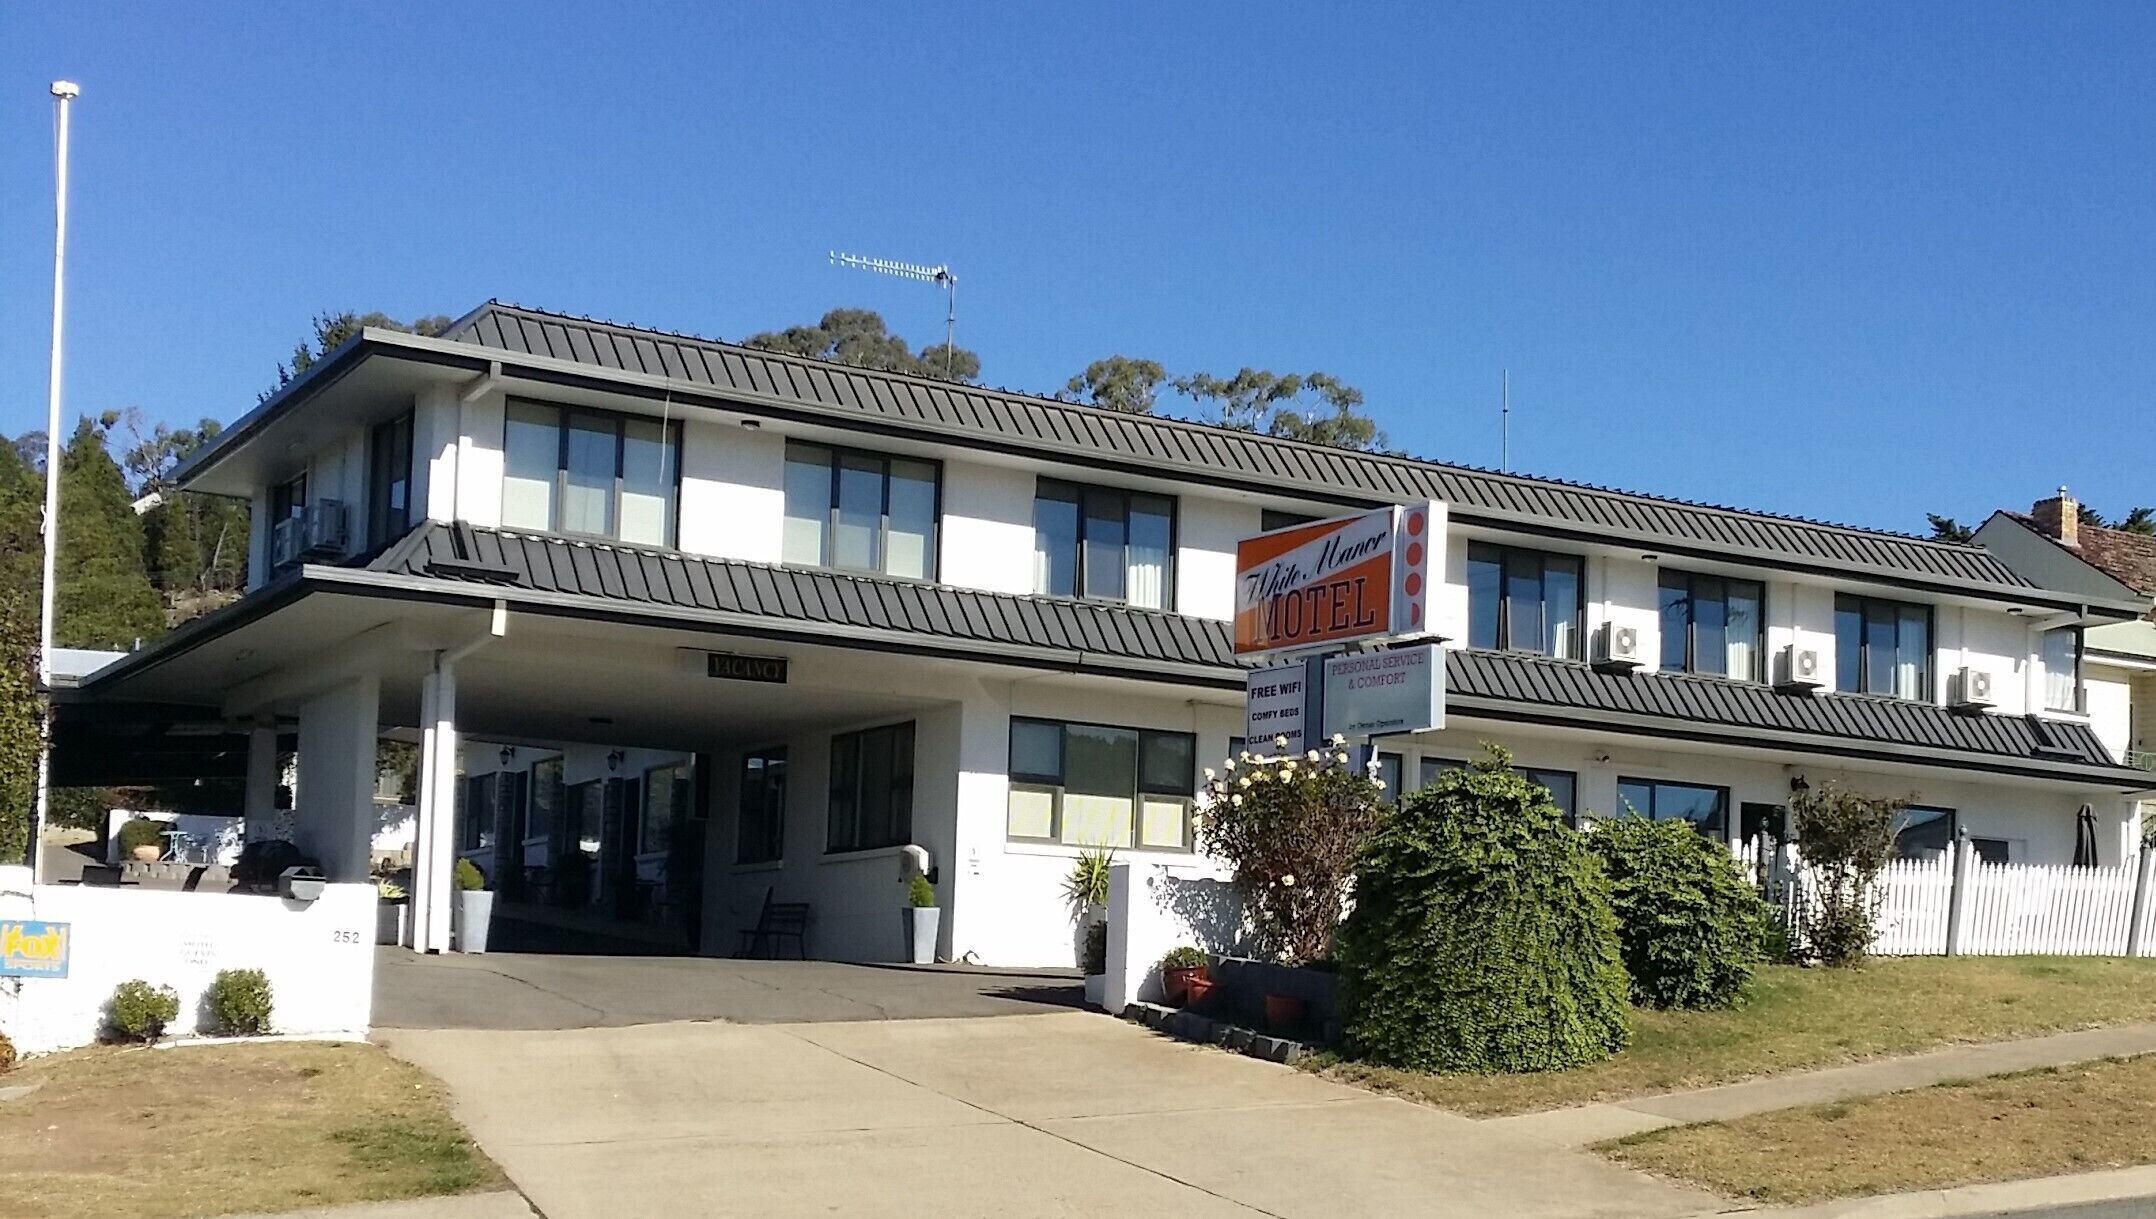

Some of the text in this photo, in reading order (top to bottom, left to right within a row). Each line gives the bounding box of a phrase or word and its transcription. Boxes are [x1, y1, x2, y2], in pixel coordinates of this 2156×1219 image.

[1247, 562, 1301, 601] White
[1254, 576, 1376, 642] MOTEL
[1332, 653, 1424, 676] PERSONAL SERVICE
[1348, 672, 1406, 690] & COMFORT
[1251, 681, 1301, 700] FREE WIFI
[1251, 707, 1299, 721] COMFY BEDS
[1249, 733, 1273, 745] CLEAN
[1, 924, 68, 960] FOX
[333, 930, 360, 944] 252
[5, 960, 61, 972] SPORTS
